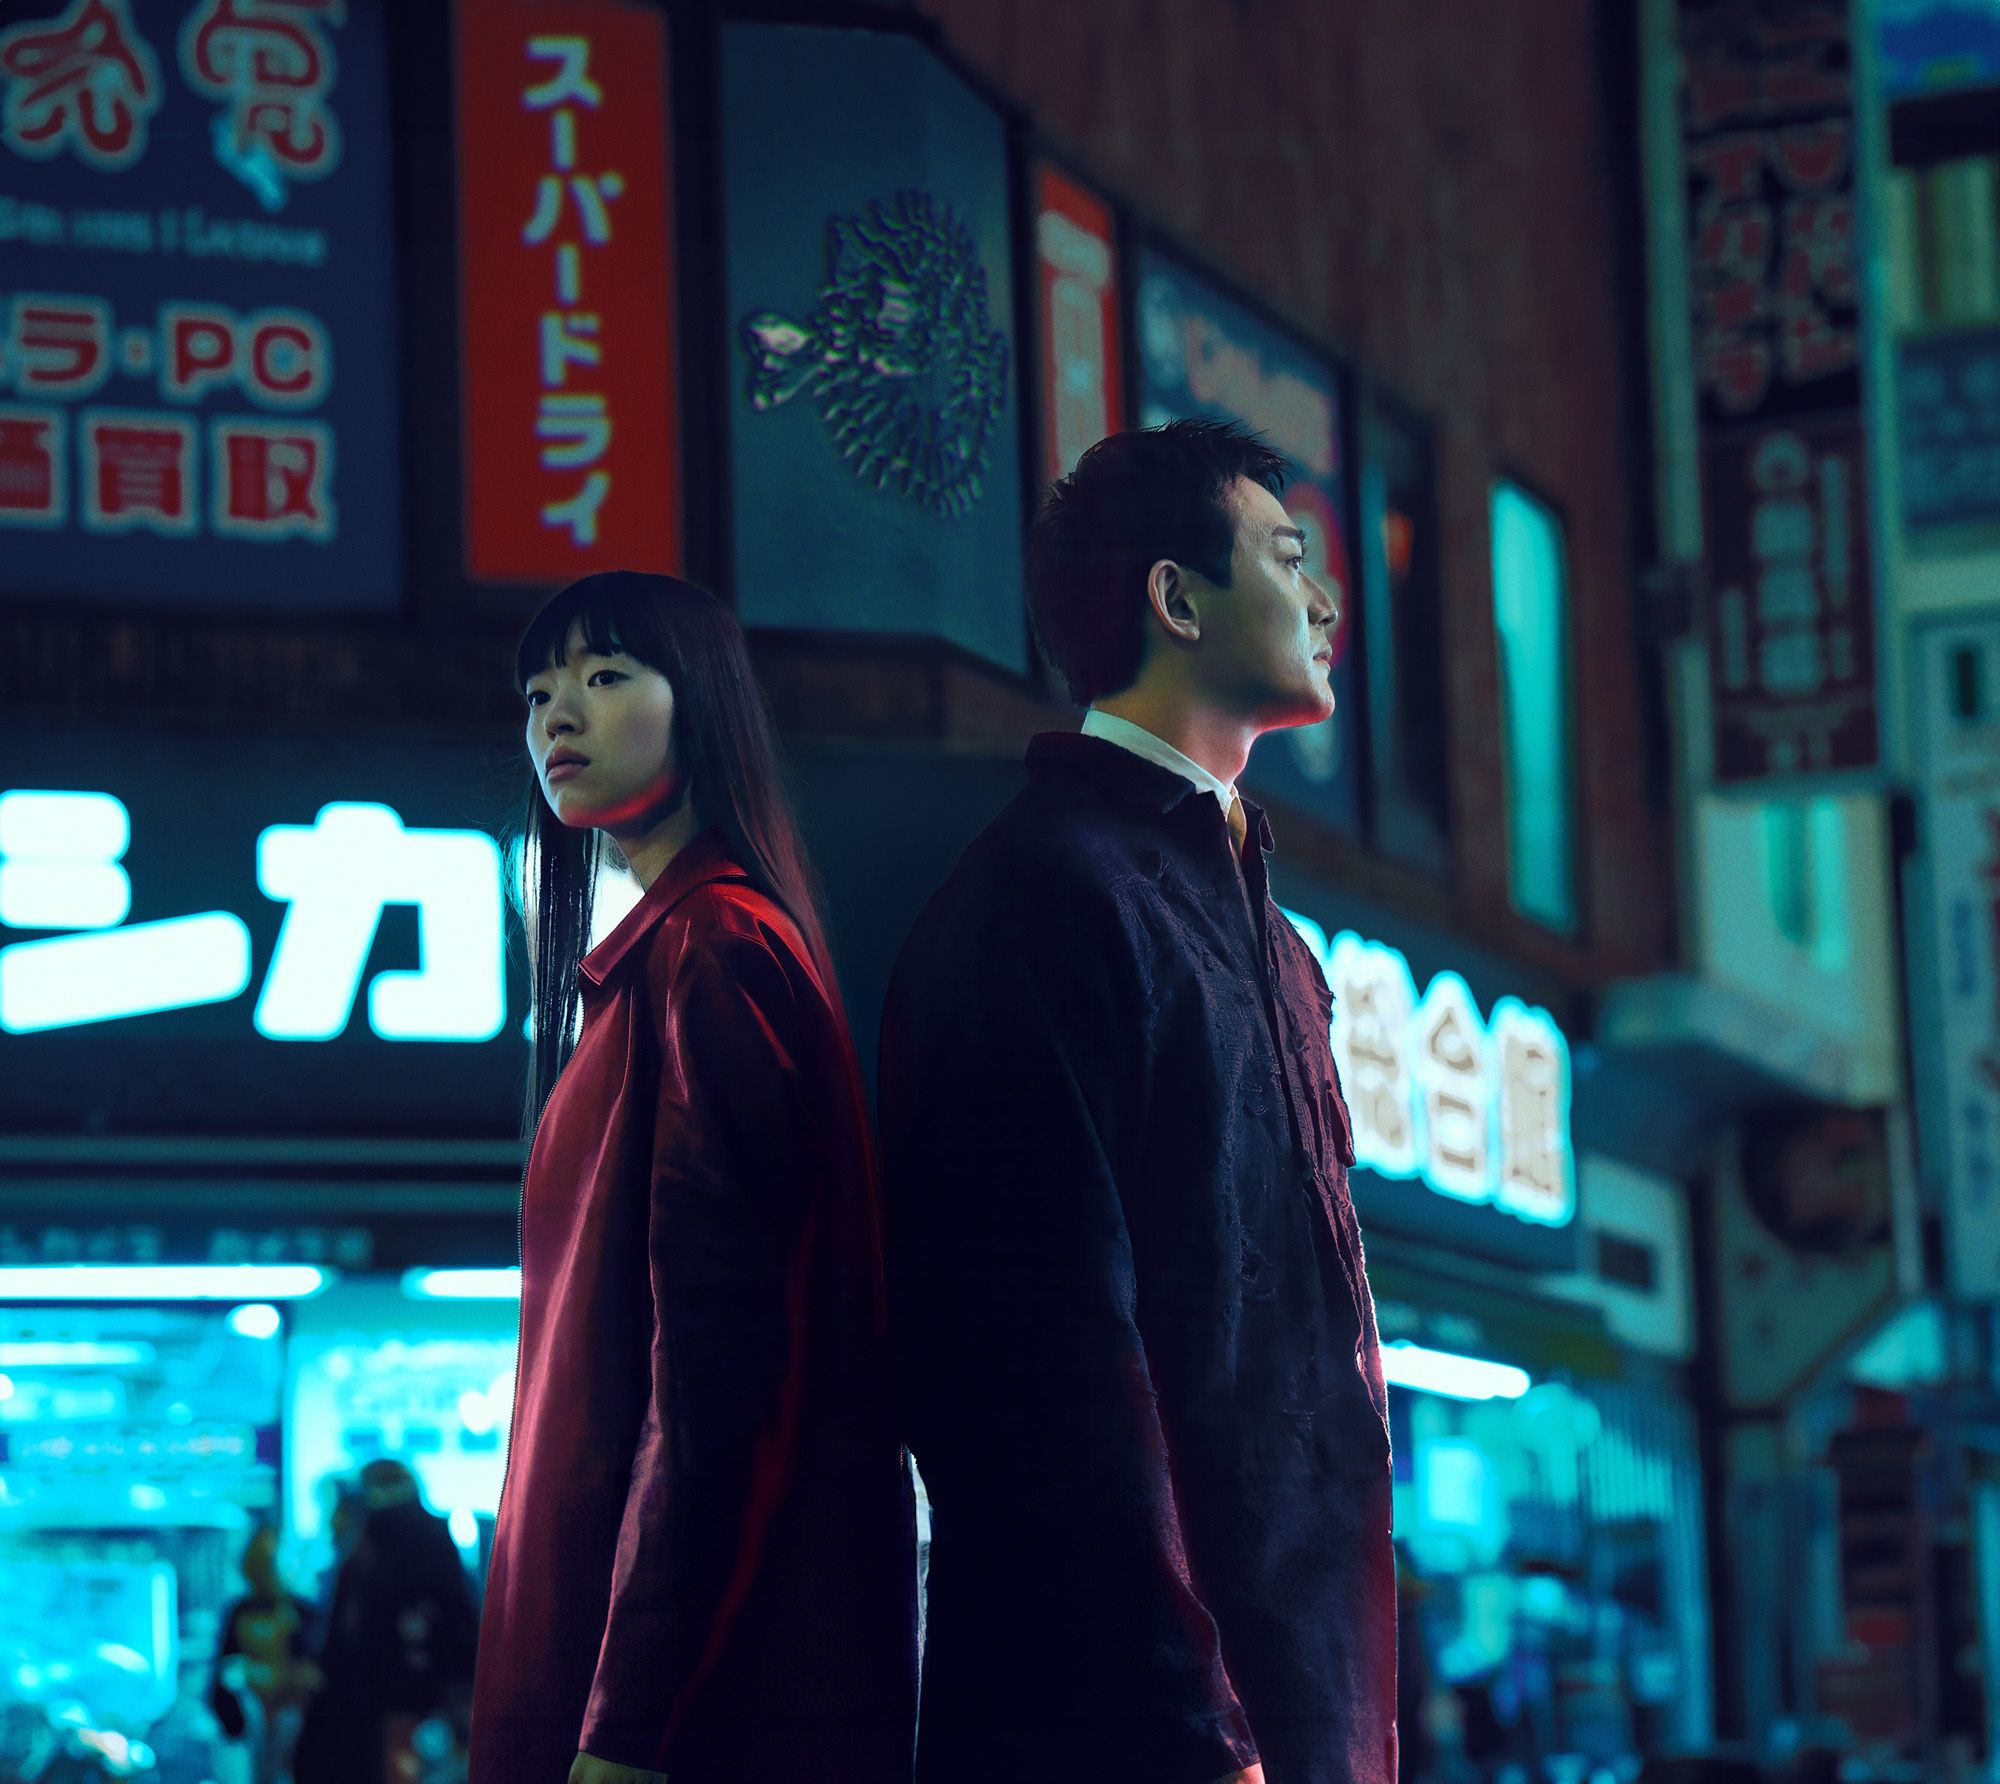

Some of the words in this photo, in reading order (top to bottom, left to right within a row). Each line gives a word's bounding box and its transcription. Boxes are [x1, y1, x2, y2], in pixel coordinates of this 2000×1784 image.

[522, 36, 624, 547] スーパードライ
[0, 788, 635, 1042] シカ
